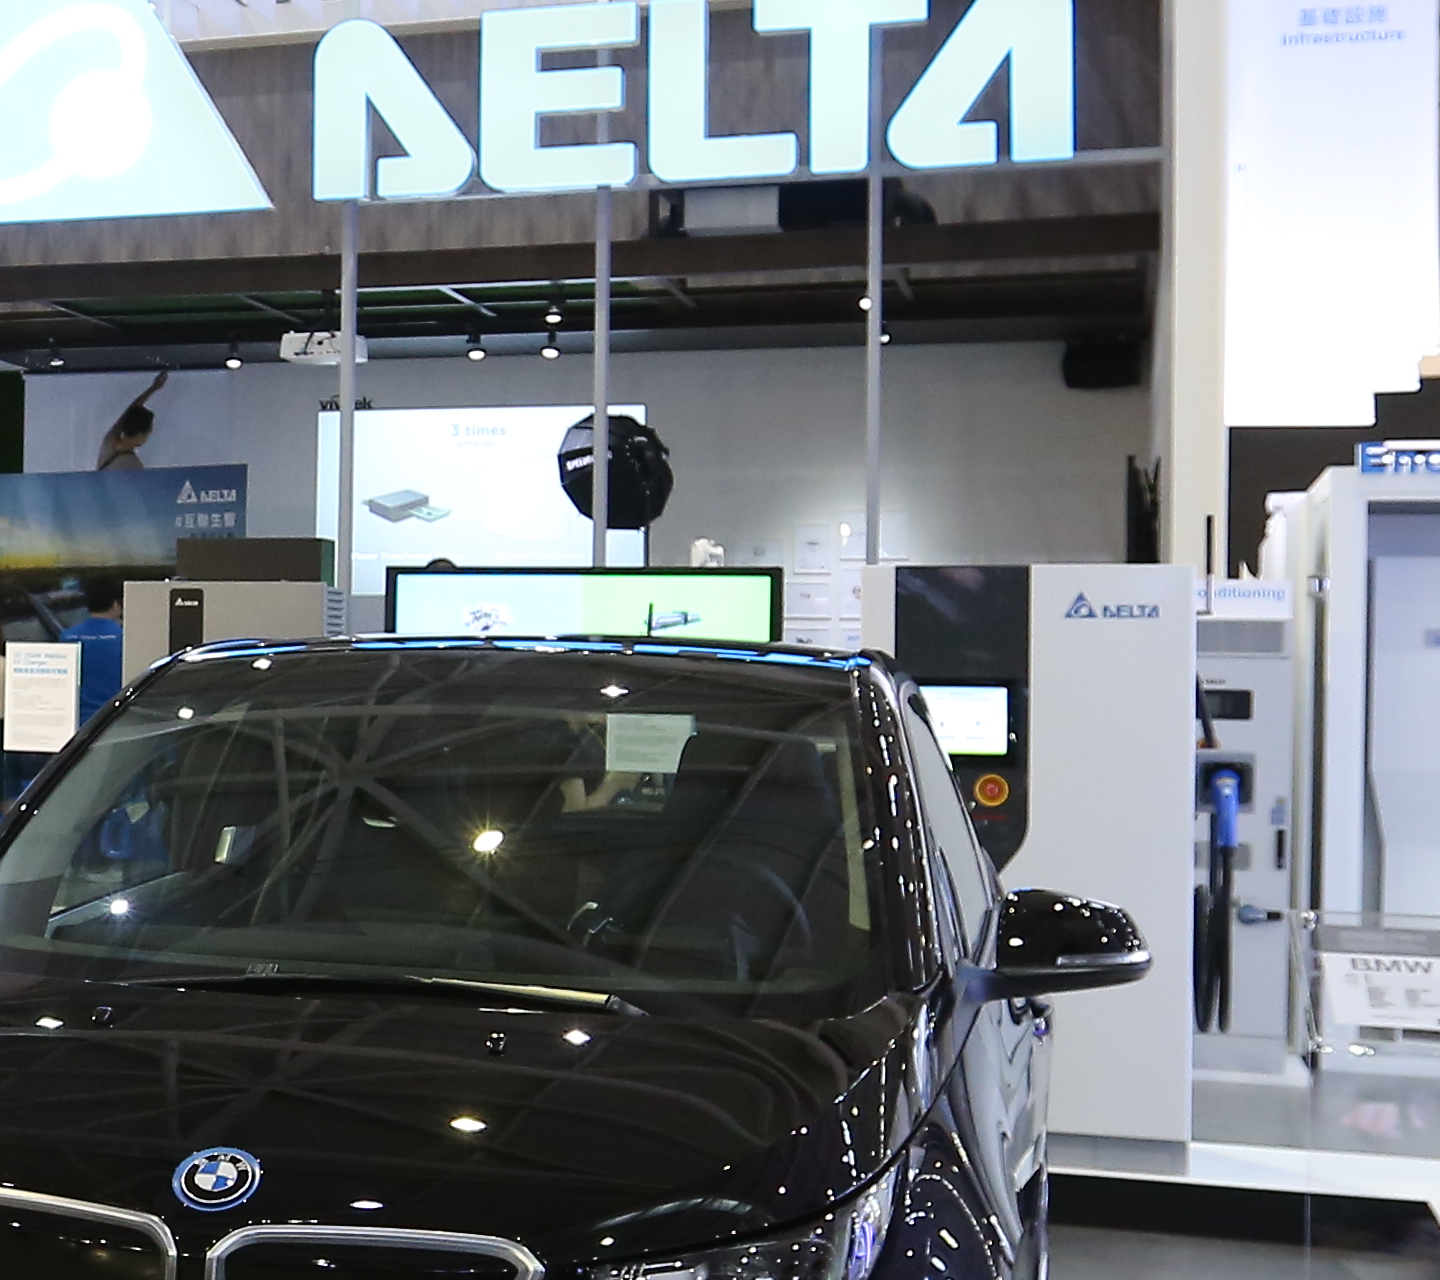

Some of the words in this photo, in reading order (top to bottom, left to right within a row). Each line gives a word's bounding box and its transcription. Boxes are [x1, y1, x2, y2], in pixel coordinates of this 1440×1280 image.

[451, 423, 460, 437] 3
[465, 423, 507, 437] times
[200, 488, 238, 503] DELTA
[1102, 604, 1161, 619] DELTA
[1351, 957, 1434, 974] BMW
